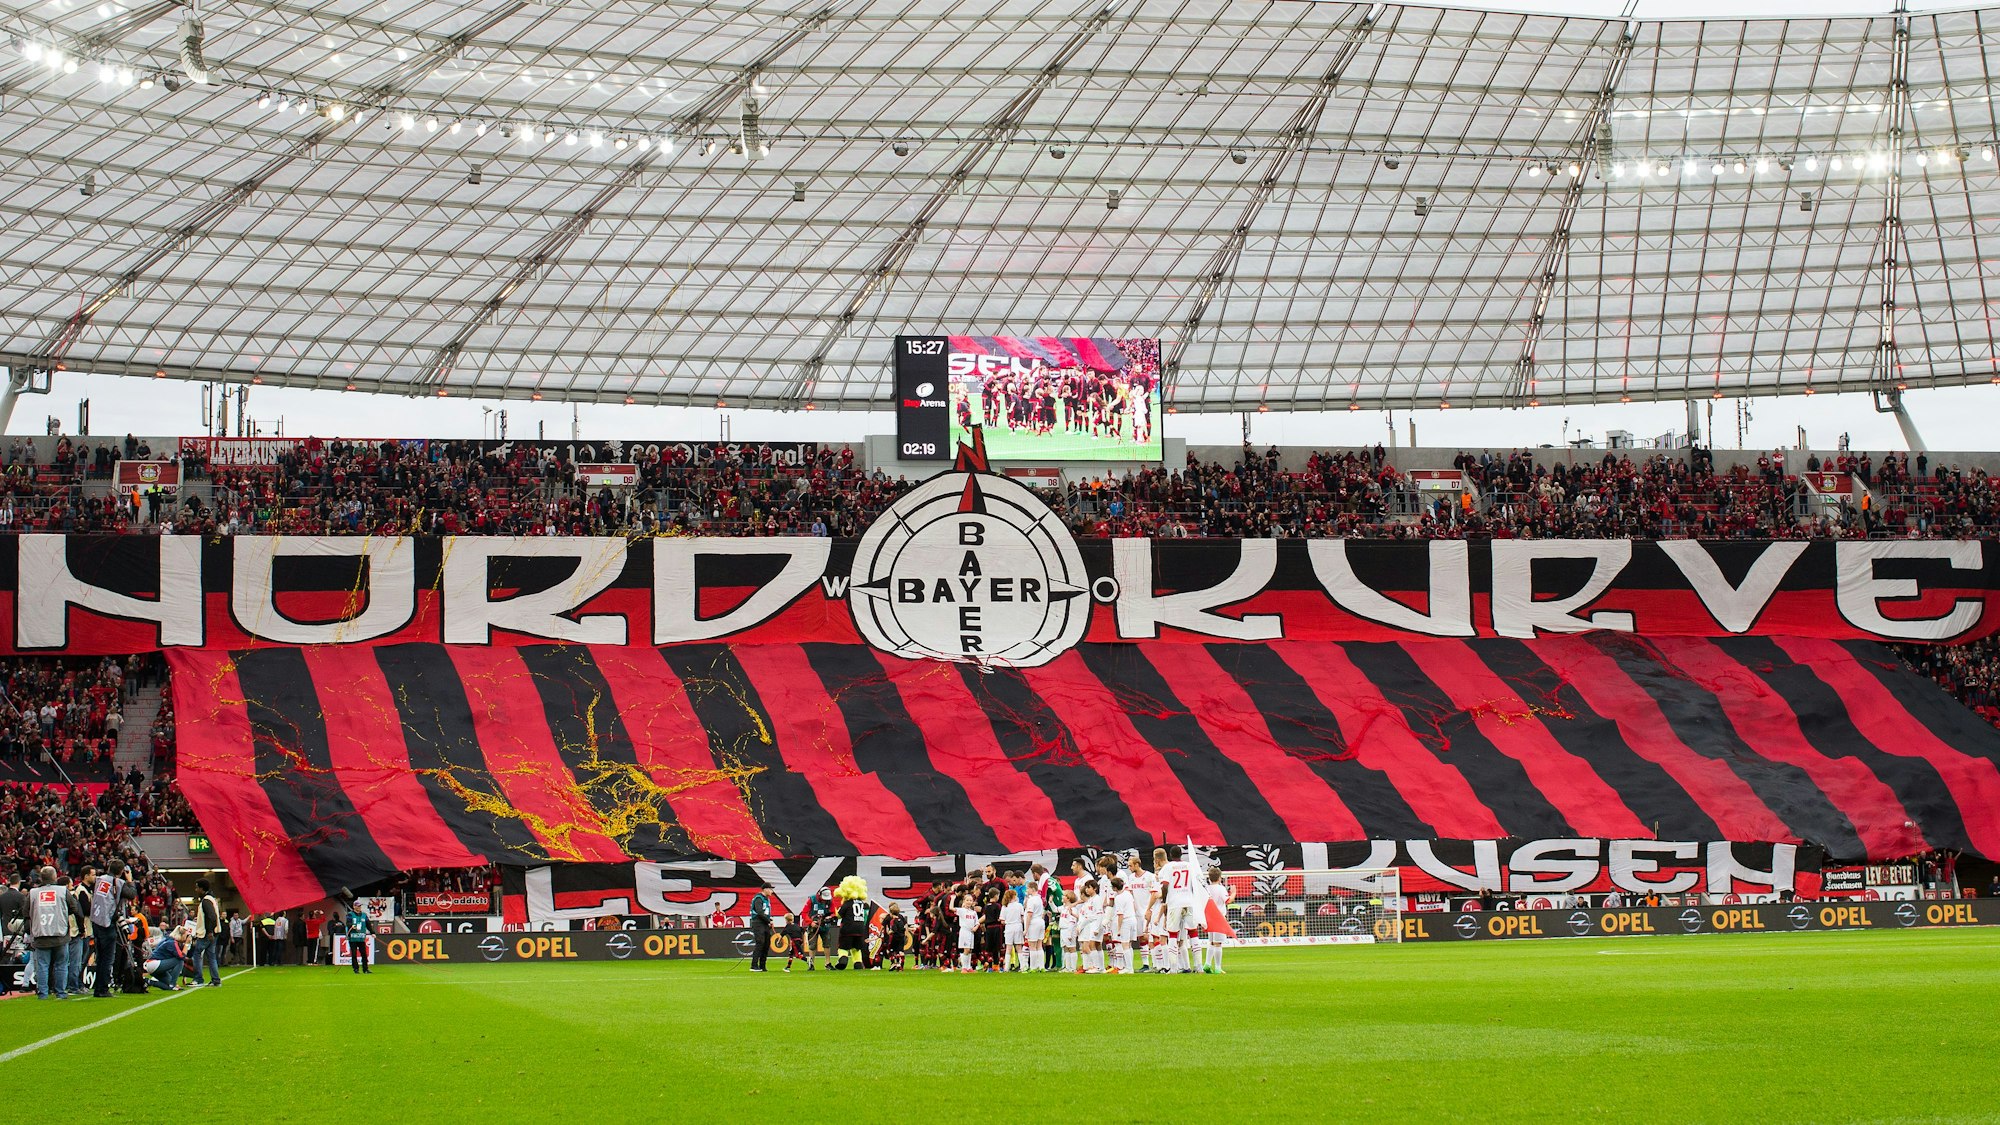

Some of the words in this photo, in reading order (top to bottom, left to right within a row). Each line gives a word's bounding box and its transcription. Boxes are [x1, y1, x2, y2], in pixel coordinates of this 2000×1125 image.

[906, 341, 944, 354] 15:27
[904, 399, 946, 408] BayArena
[903, 443, 936, 455] 02:19
[822, 575, 850, 598] W
[898, 577, 1042, 603] BAYER
[958, 522, 986, 653] BAYER
[1092, 576, 1120, 603] O
[1112, 537, 1984, 641] KURVE
[1172, 869, 1189, 889] 27
[1866, 867, 1881, 885] LEV
[417, 897, 436, 905] LEV
[453, 896, 488, 905] addicts
[1418, 893, 1441, 903] BOYZ
[40, 913, 55, 926] 37
[1601, 912, 1655, 933] OPEL
[1712, 909, 1765, 930] OPEL
[1820, 906, 1872, 927] OPEL
[1927, 904, 1978, 924] OPEL
[1374, 918, 1430, 940] OPEL
[1488, 915, 1543, 936] OPEL
[387, 938, 450, 960] OPEL
[516, 937, 578, 958] OPEL
[644, 934, 705, 956] OPEL
